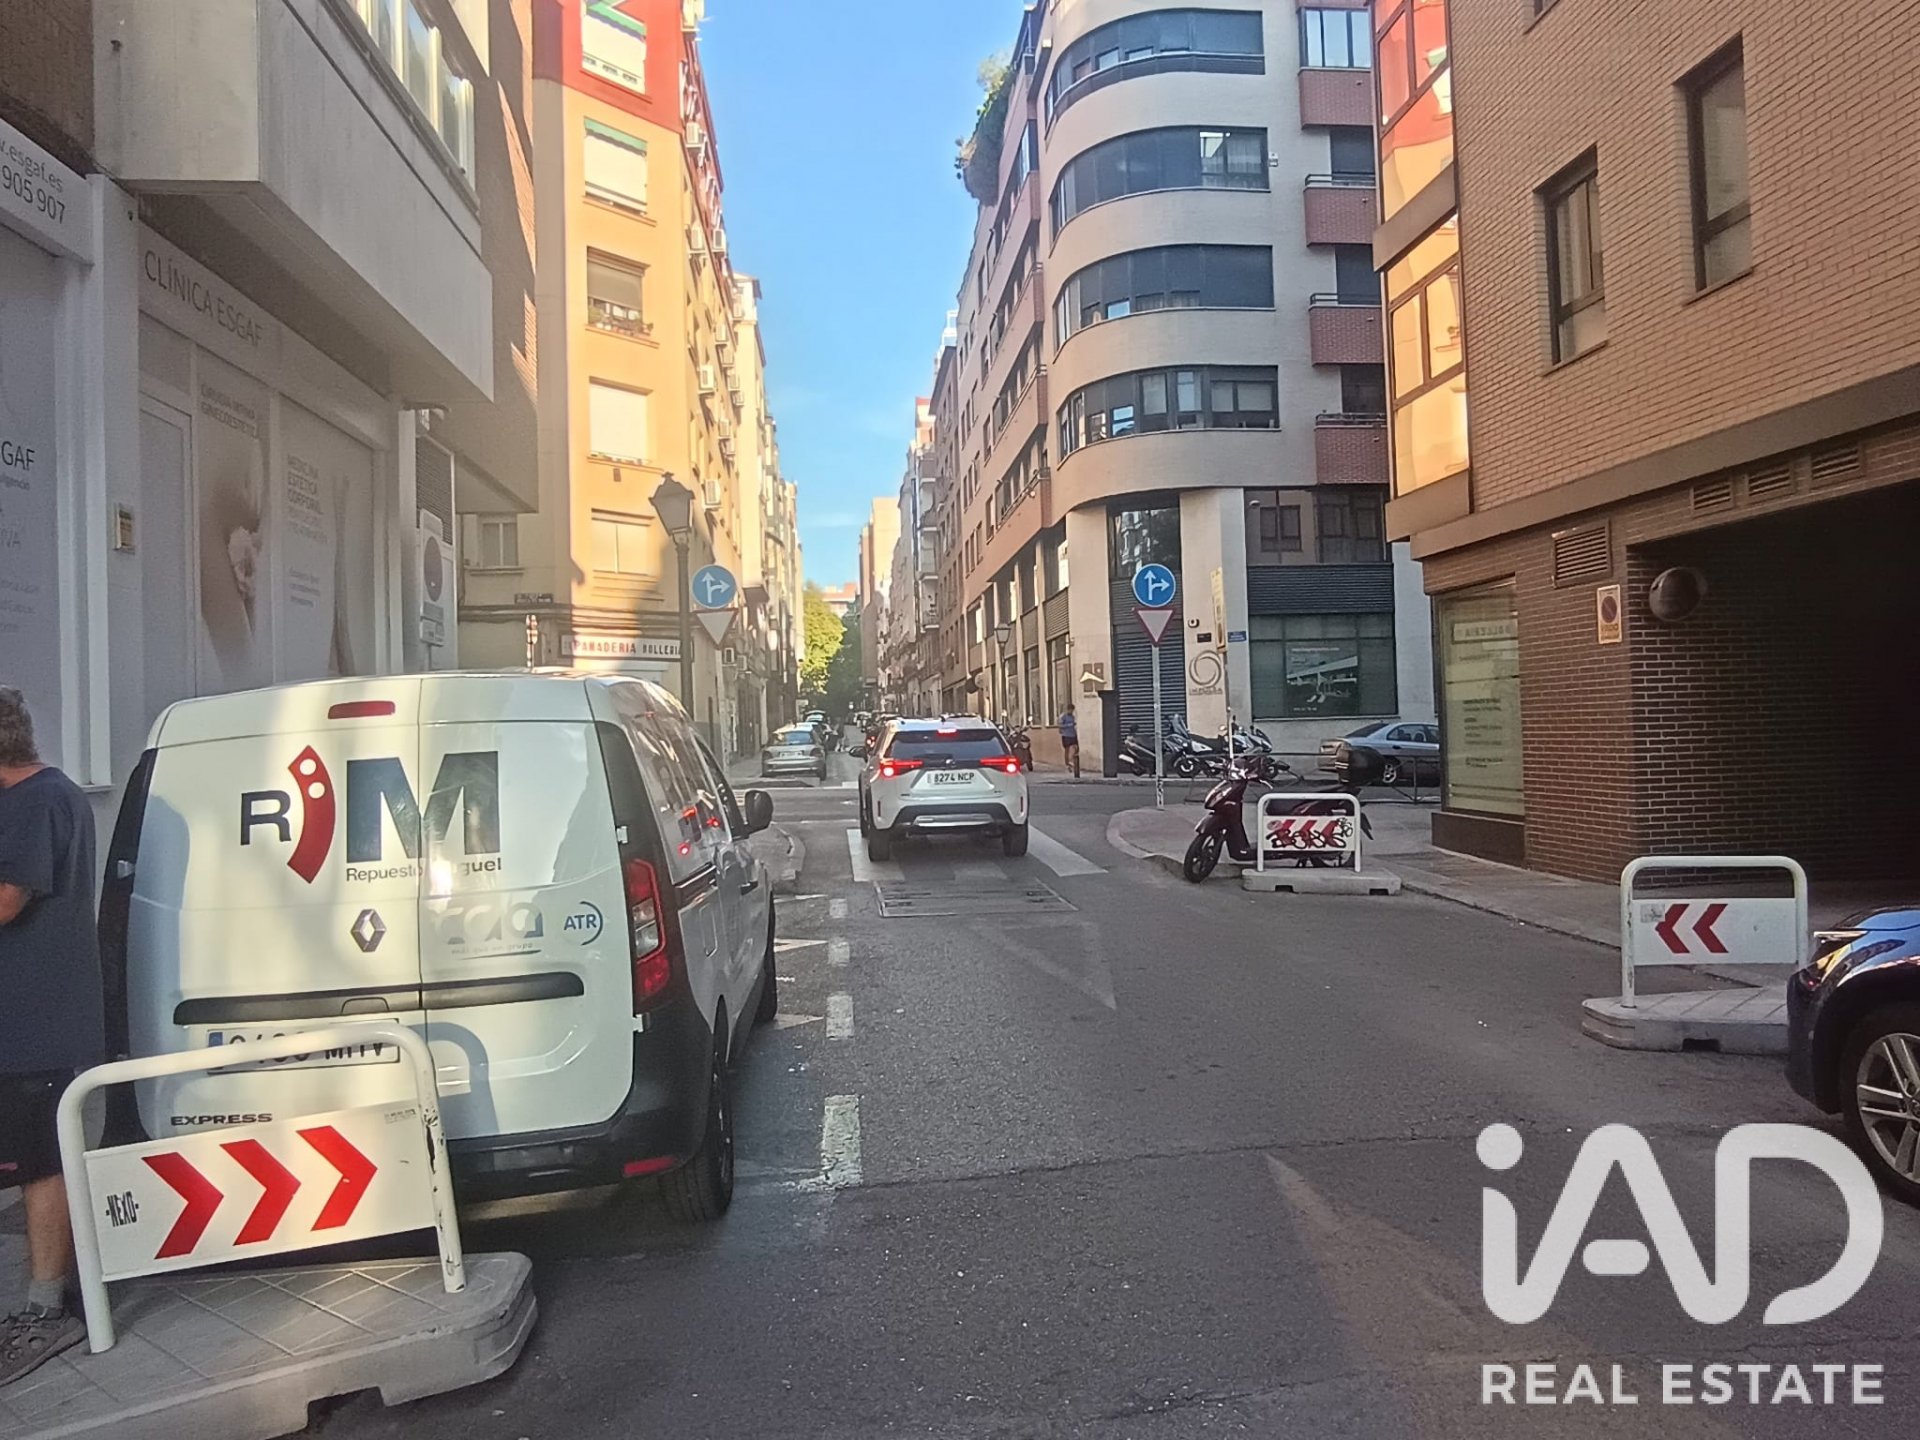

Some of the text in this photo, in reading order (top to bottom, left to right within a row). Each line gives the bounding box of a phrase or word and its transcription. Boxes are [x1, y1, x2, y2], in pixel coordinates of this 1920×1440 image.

[2, 165, 65, 225] 905 907
[217, 297, 263, 347] ESGAF
[1, 440, 36, 471] GAF
[573, 639, 636, 654] PANADERIA
[957, 772, 975, 782] NCP
[563, 913, 598, 931] ATR
[170, 1113, 273, 1126] EXPRESS
